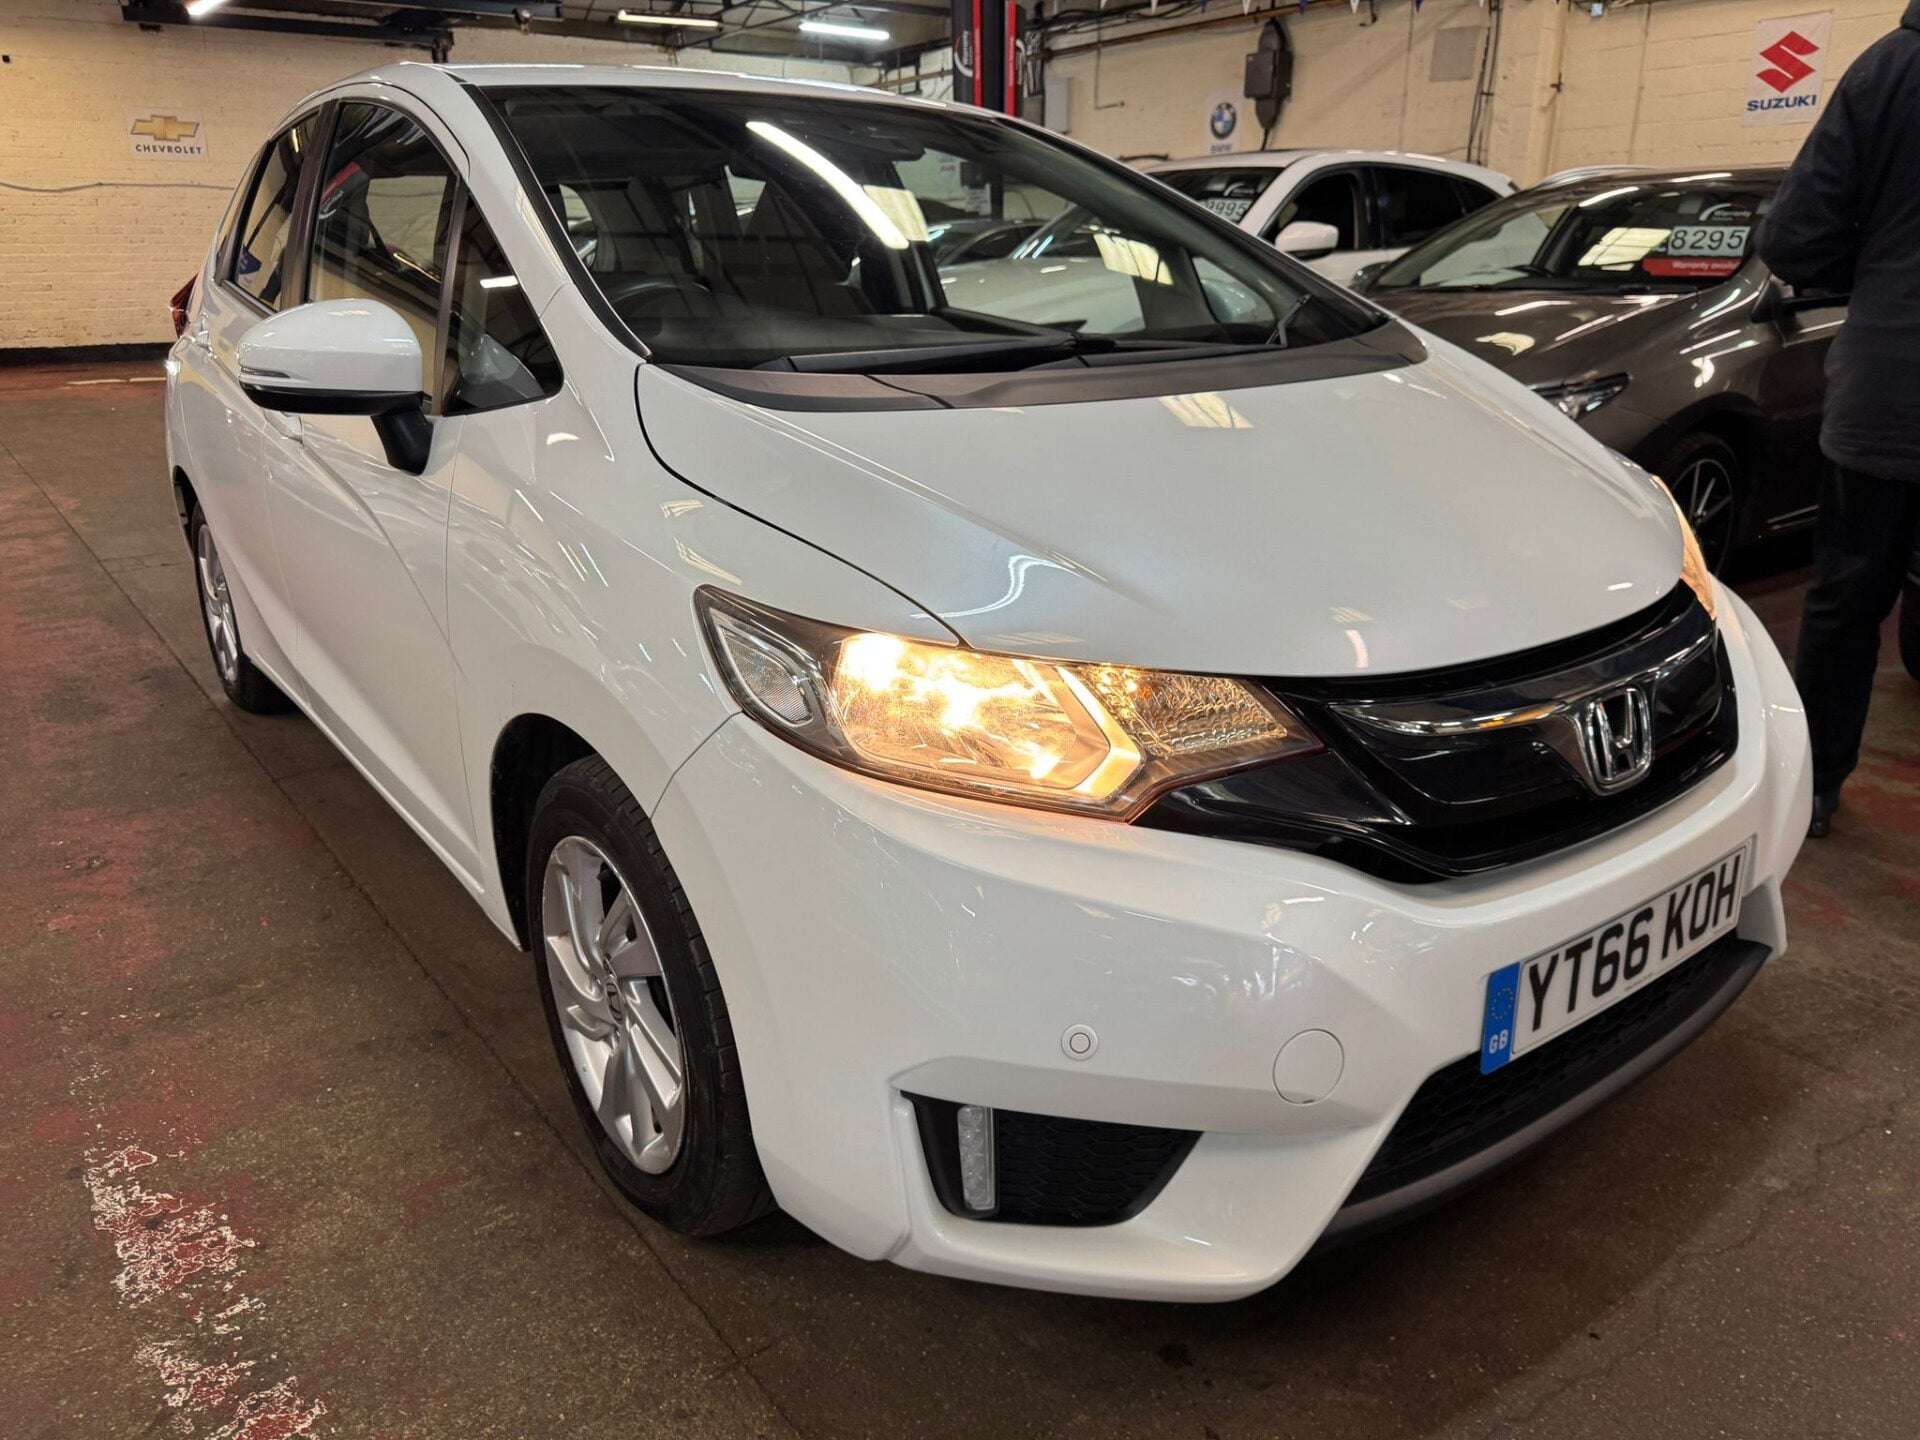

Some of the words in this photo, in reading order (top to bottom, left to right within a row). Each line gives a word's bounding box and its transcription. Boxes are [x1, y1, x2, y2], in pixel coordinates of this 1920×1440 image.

[1747, 95, 1817, 111] SUZUKI
[135, 144, 202, 154] CHEVROLET
[1671, 229, 1745, 250] 8295
[1529, 907, 1653, 1031] YT66
[1661, 854, 1742, 960] KOH
[1489, 1030, 1508, 1054] GB
